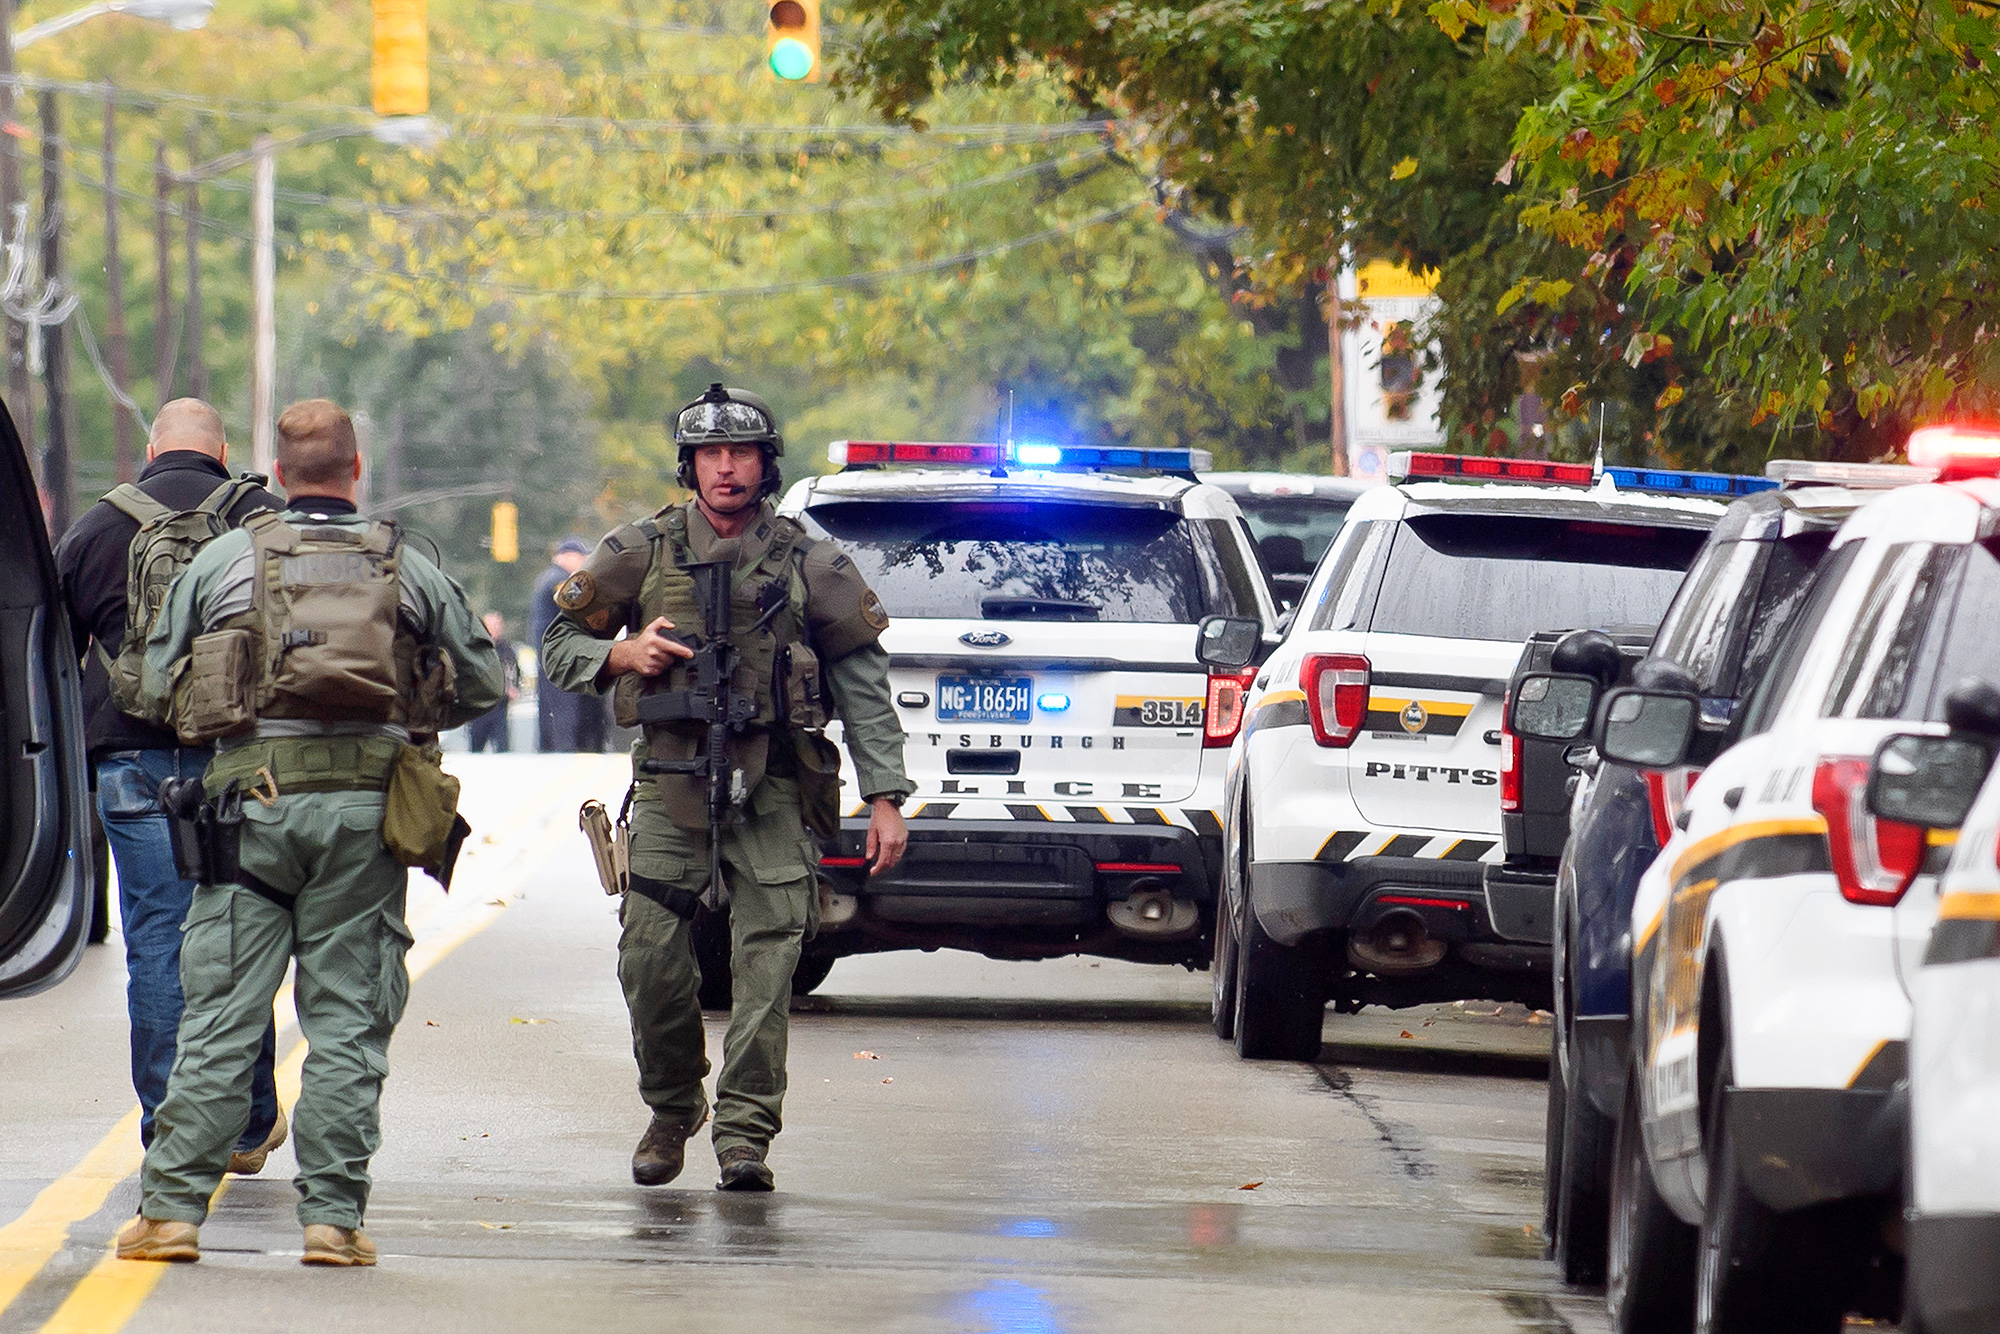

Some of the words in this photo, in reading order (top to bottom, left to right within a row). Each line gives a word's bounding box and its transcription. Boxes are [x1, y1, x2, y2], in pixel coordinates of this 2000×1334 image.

[969, 631, 1001, 644] Ford
[941, 686, 1028, 712] MG-1865H
[1142, 700, 1201, 724] 3514
[842, 730, 1125, 749] TSBURGH
[839, 779, 1161, 797] LICE
